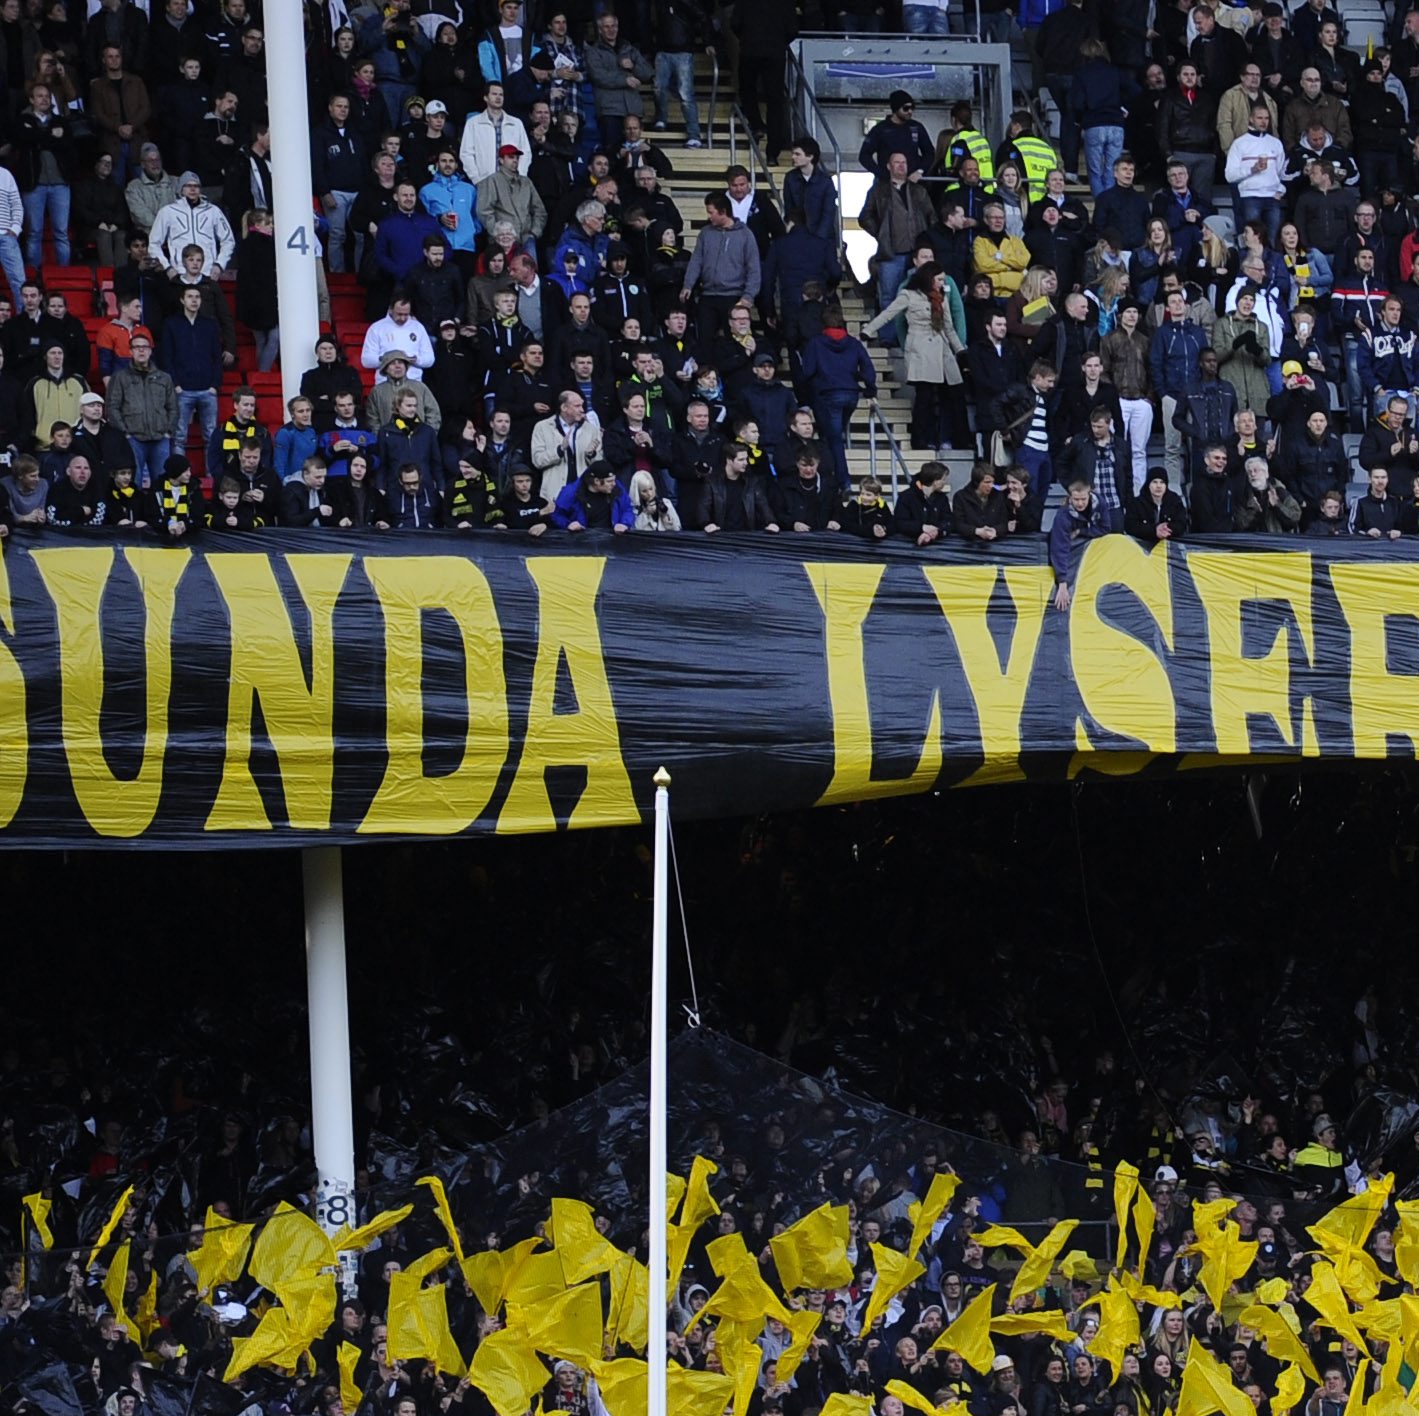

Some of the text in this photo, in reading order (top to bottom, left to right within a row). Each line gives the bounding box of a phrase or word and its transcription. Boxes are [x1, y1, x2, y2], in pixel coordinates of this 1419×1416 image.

[286, 226, 310, 256] 4
[0, 528, 641, 837] UNDA
[326, 1195, 349, 1226] 8
